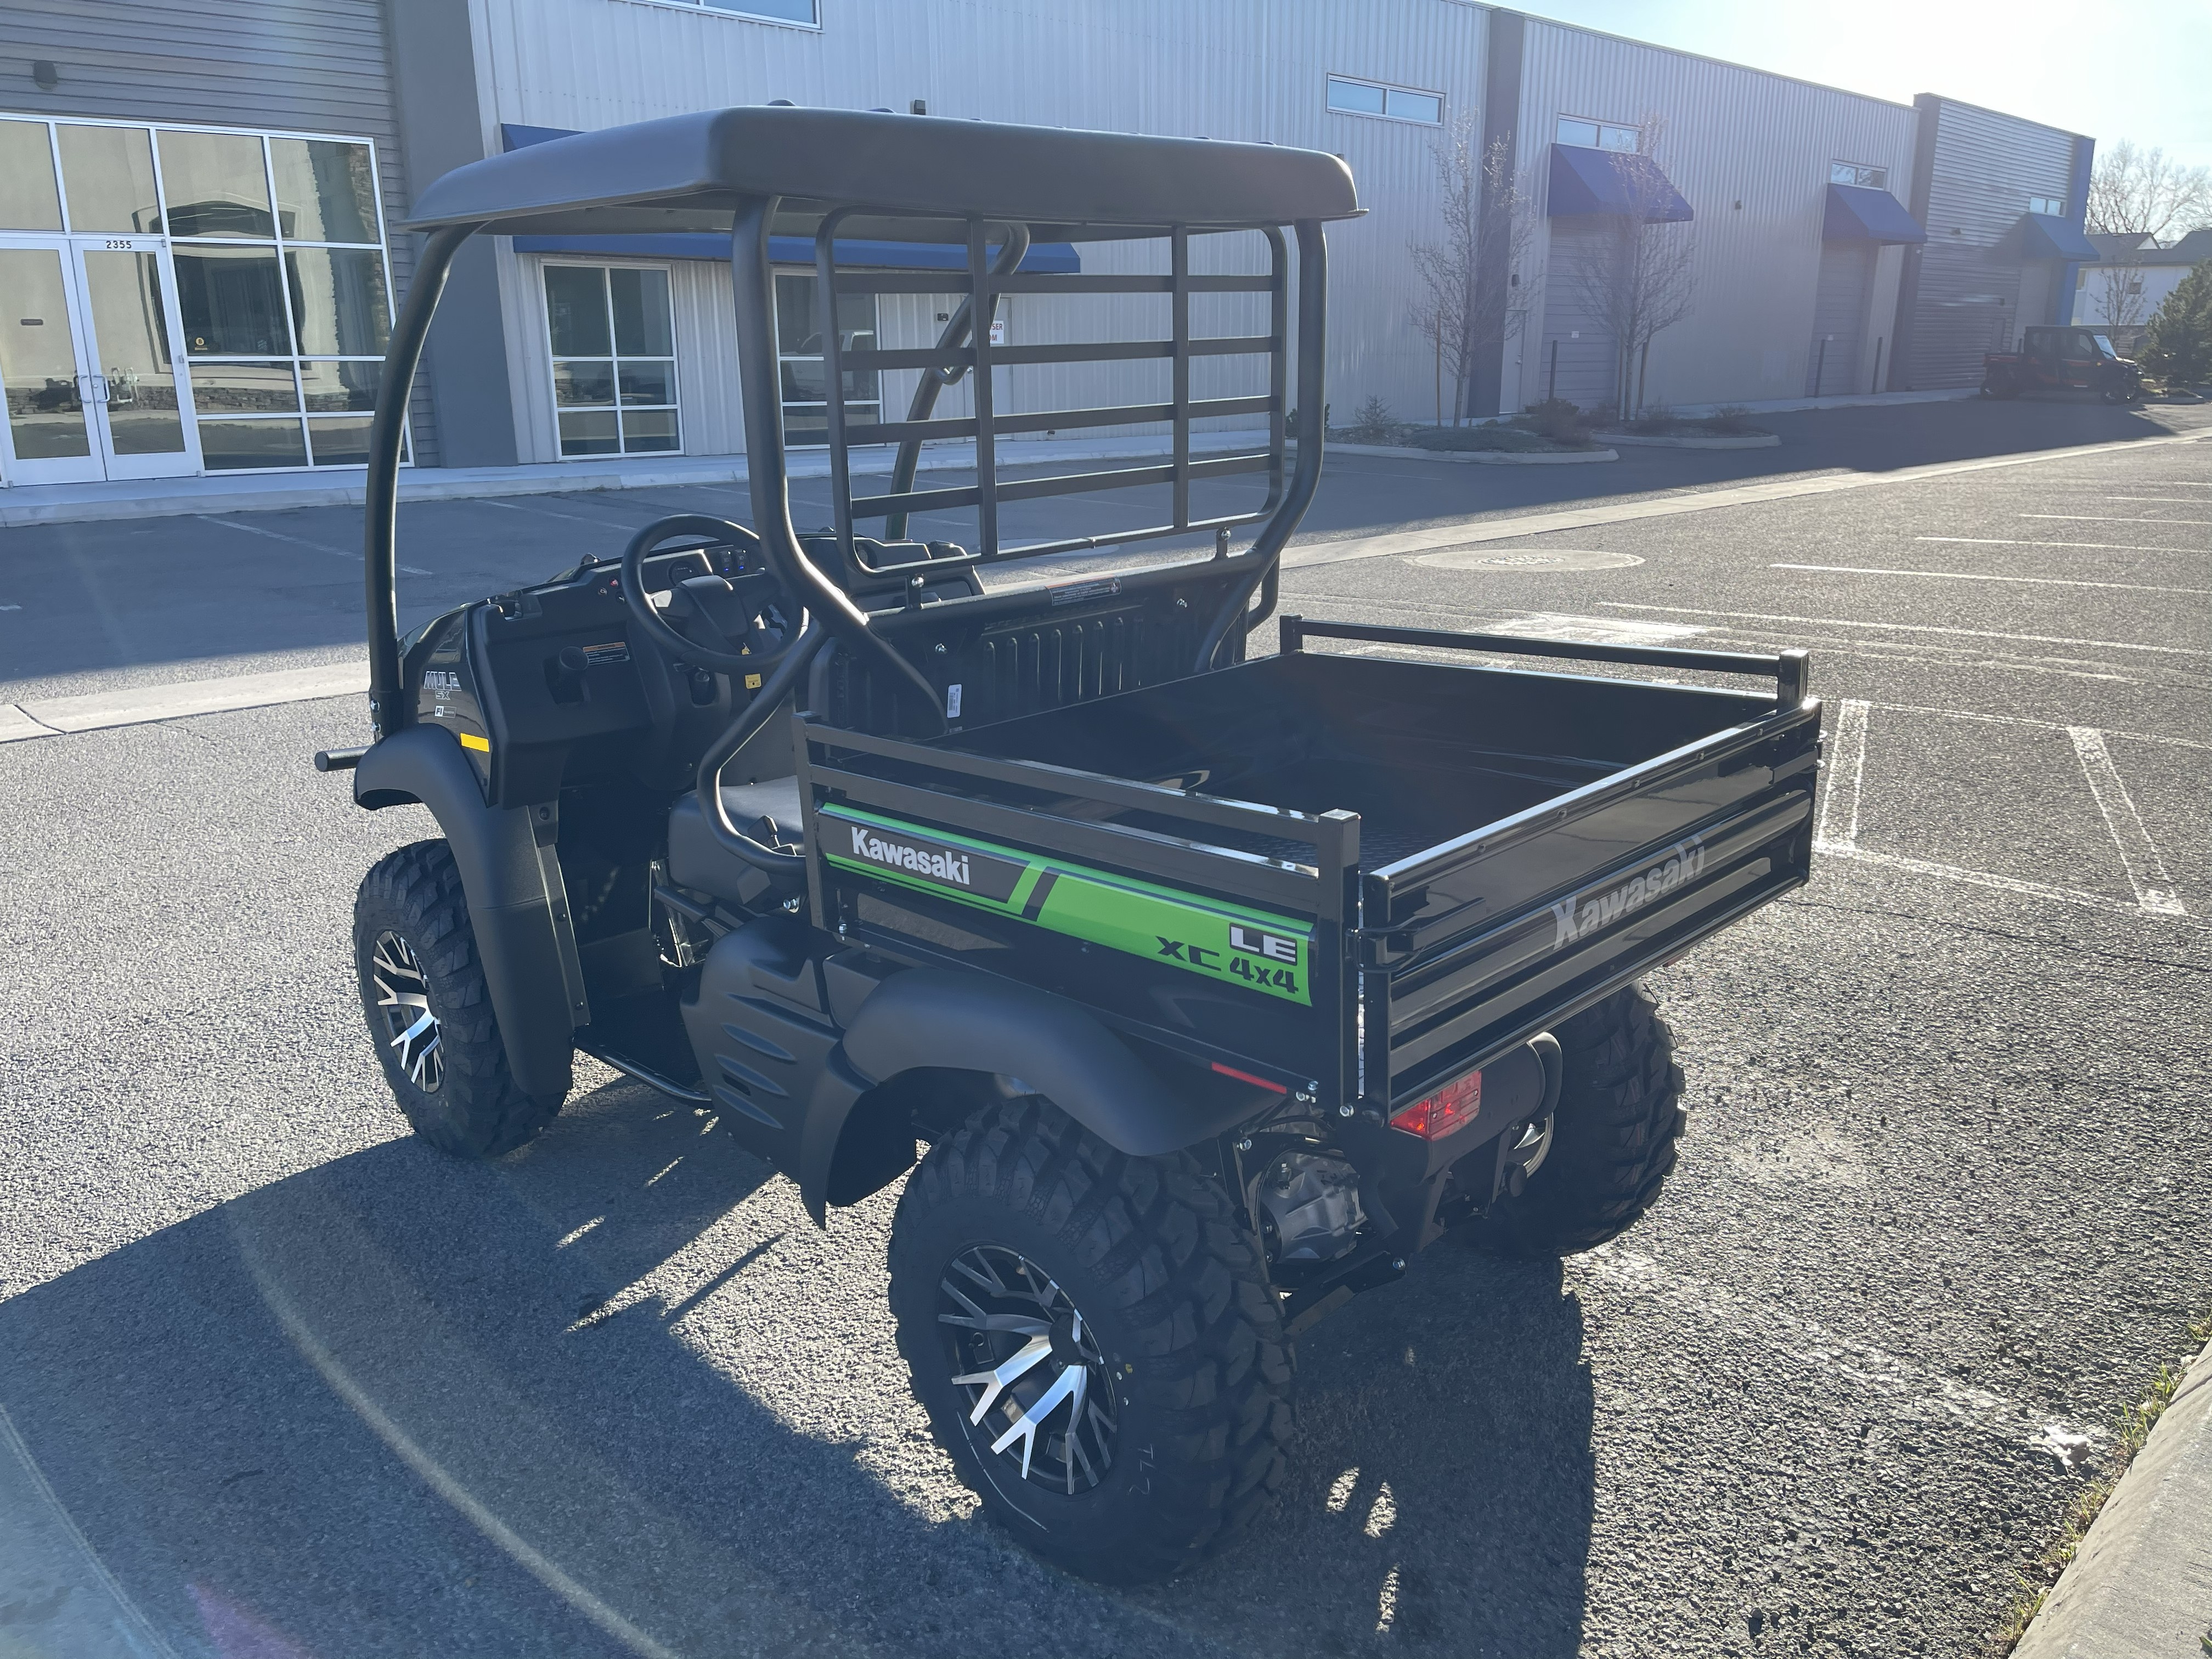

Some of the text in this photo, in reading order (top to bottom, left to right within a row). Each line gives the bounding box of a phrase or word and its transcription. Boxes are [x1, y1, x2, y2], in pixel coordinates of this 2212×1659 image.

[106, 240, 132, 249] 2355
[424, 671, 462, 691] MULE
[435, 690, 451, 701] SX
[851, 826, 970, 885] Kawasaki
[1551, 834, 1705, 951] Kawasaki
[1231, 926, 1296, 962] LE
[1155, 935, 1299, 994] XC 4x4
